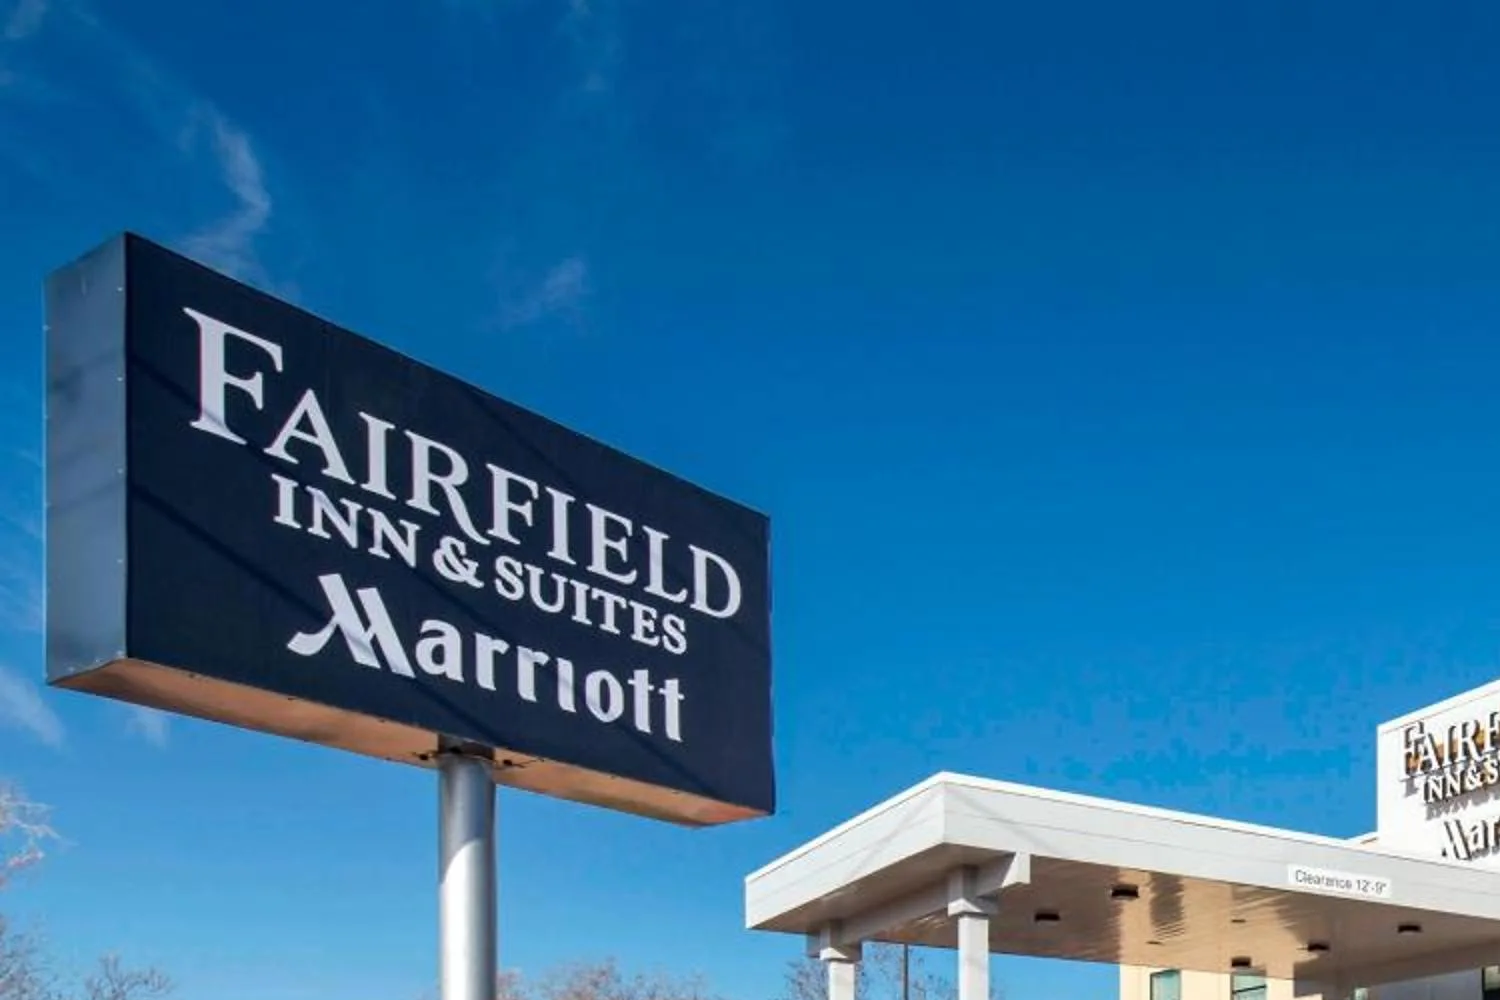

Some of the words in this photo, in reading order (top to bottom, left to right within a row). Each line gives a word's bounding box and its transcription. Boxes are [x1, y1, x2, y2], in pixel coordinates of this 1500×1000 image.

[182, 305, 743, 620] FAIRFIELD
[271, 472, 421, 568] INN
[432, 534, 485, 589] &
[494, 554, 689, 656] SUITES
[286, 572, 686, 743] Marriott
[1464, 764, 1484, 791] &
[1294, 869, 1353, 890] Clearance
